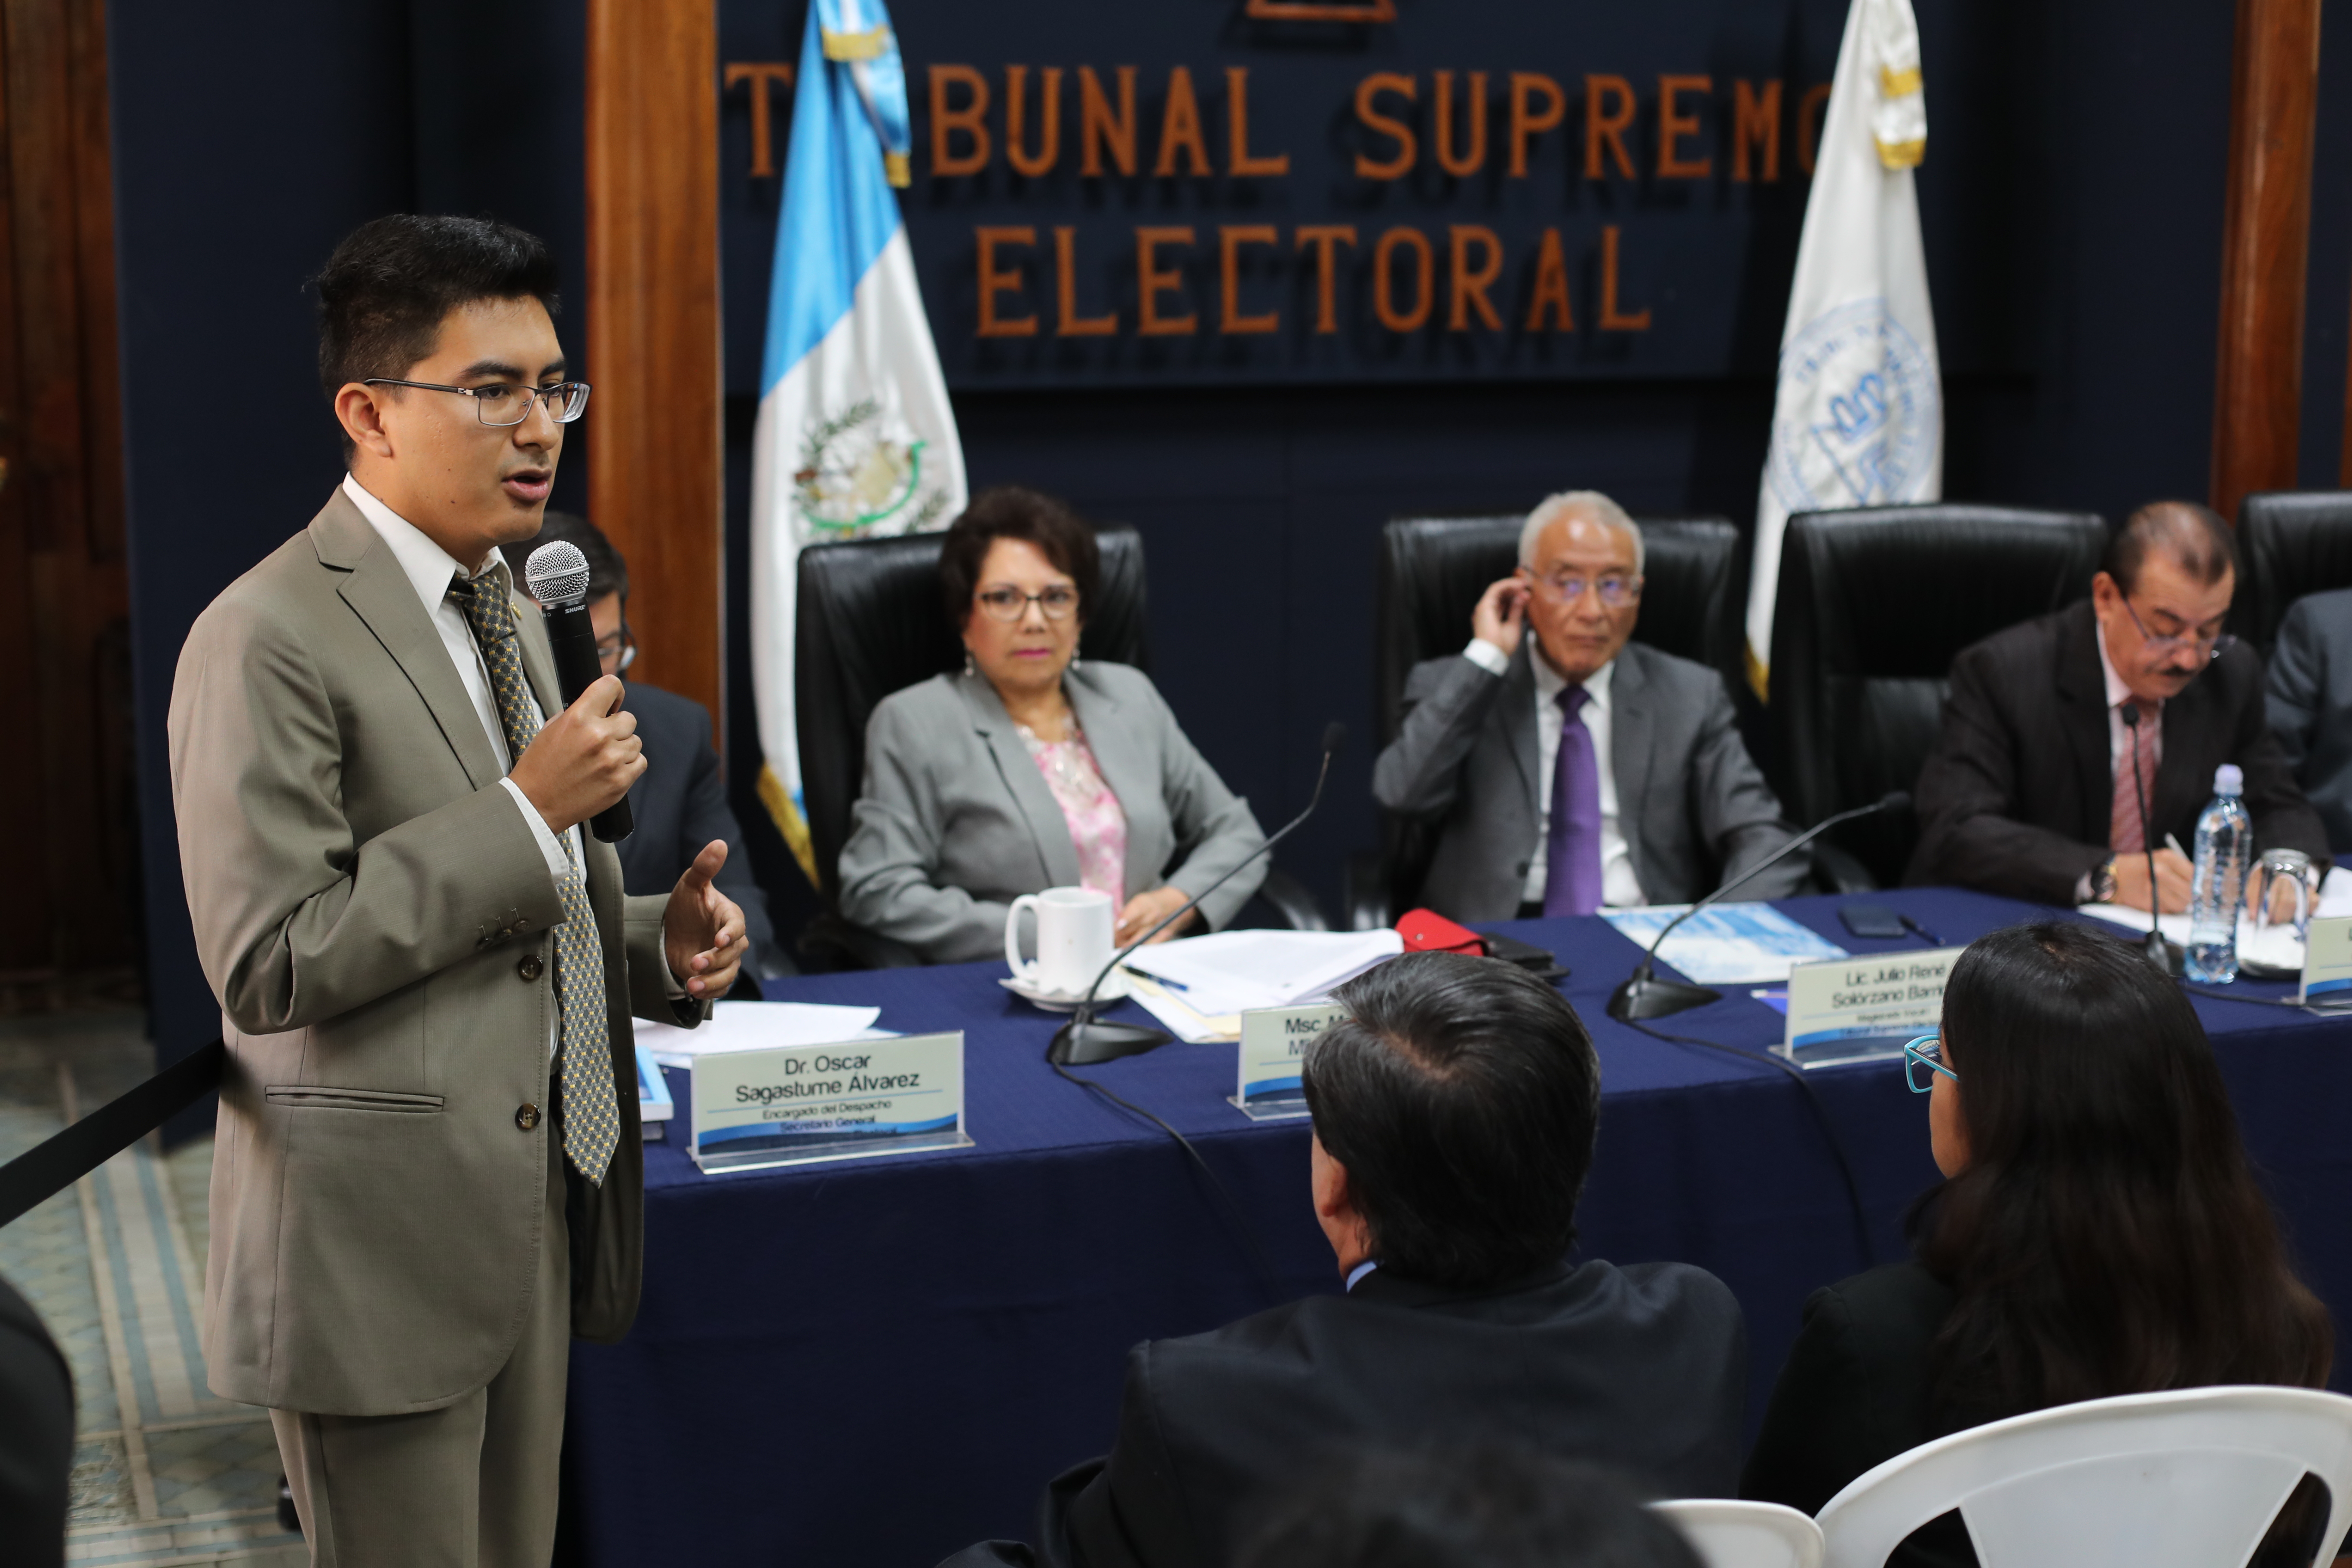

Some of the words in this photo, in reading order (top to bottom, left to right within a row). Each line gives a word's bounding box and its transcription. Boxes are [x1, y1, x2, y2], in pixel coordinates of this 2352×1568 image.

[723, 62, 1288, 177] TBUNAL
[974, 225, 1652, 335] ELECTORAL
[565, 605, 585, 614] SHURE
[1874, 968, 1905, 984] Julio
[785, 1057, 810, 1075] Dr.
[815, 1054, 871, 1072] Oscar
[736, 1079, 842, 1105] Sagastume
[848, 1071, 919, 1093] Álvarez
[763, 1106, 818, 1120] Encargado
[821, 1103, 837, 1114] del
[839, 1100, 892, 1115] Despacho
[780, 1118, 834, 1132] Secretario
[836, 1115, 876, 1127] General
